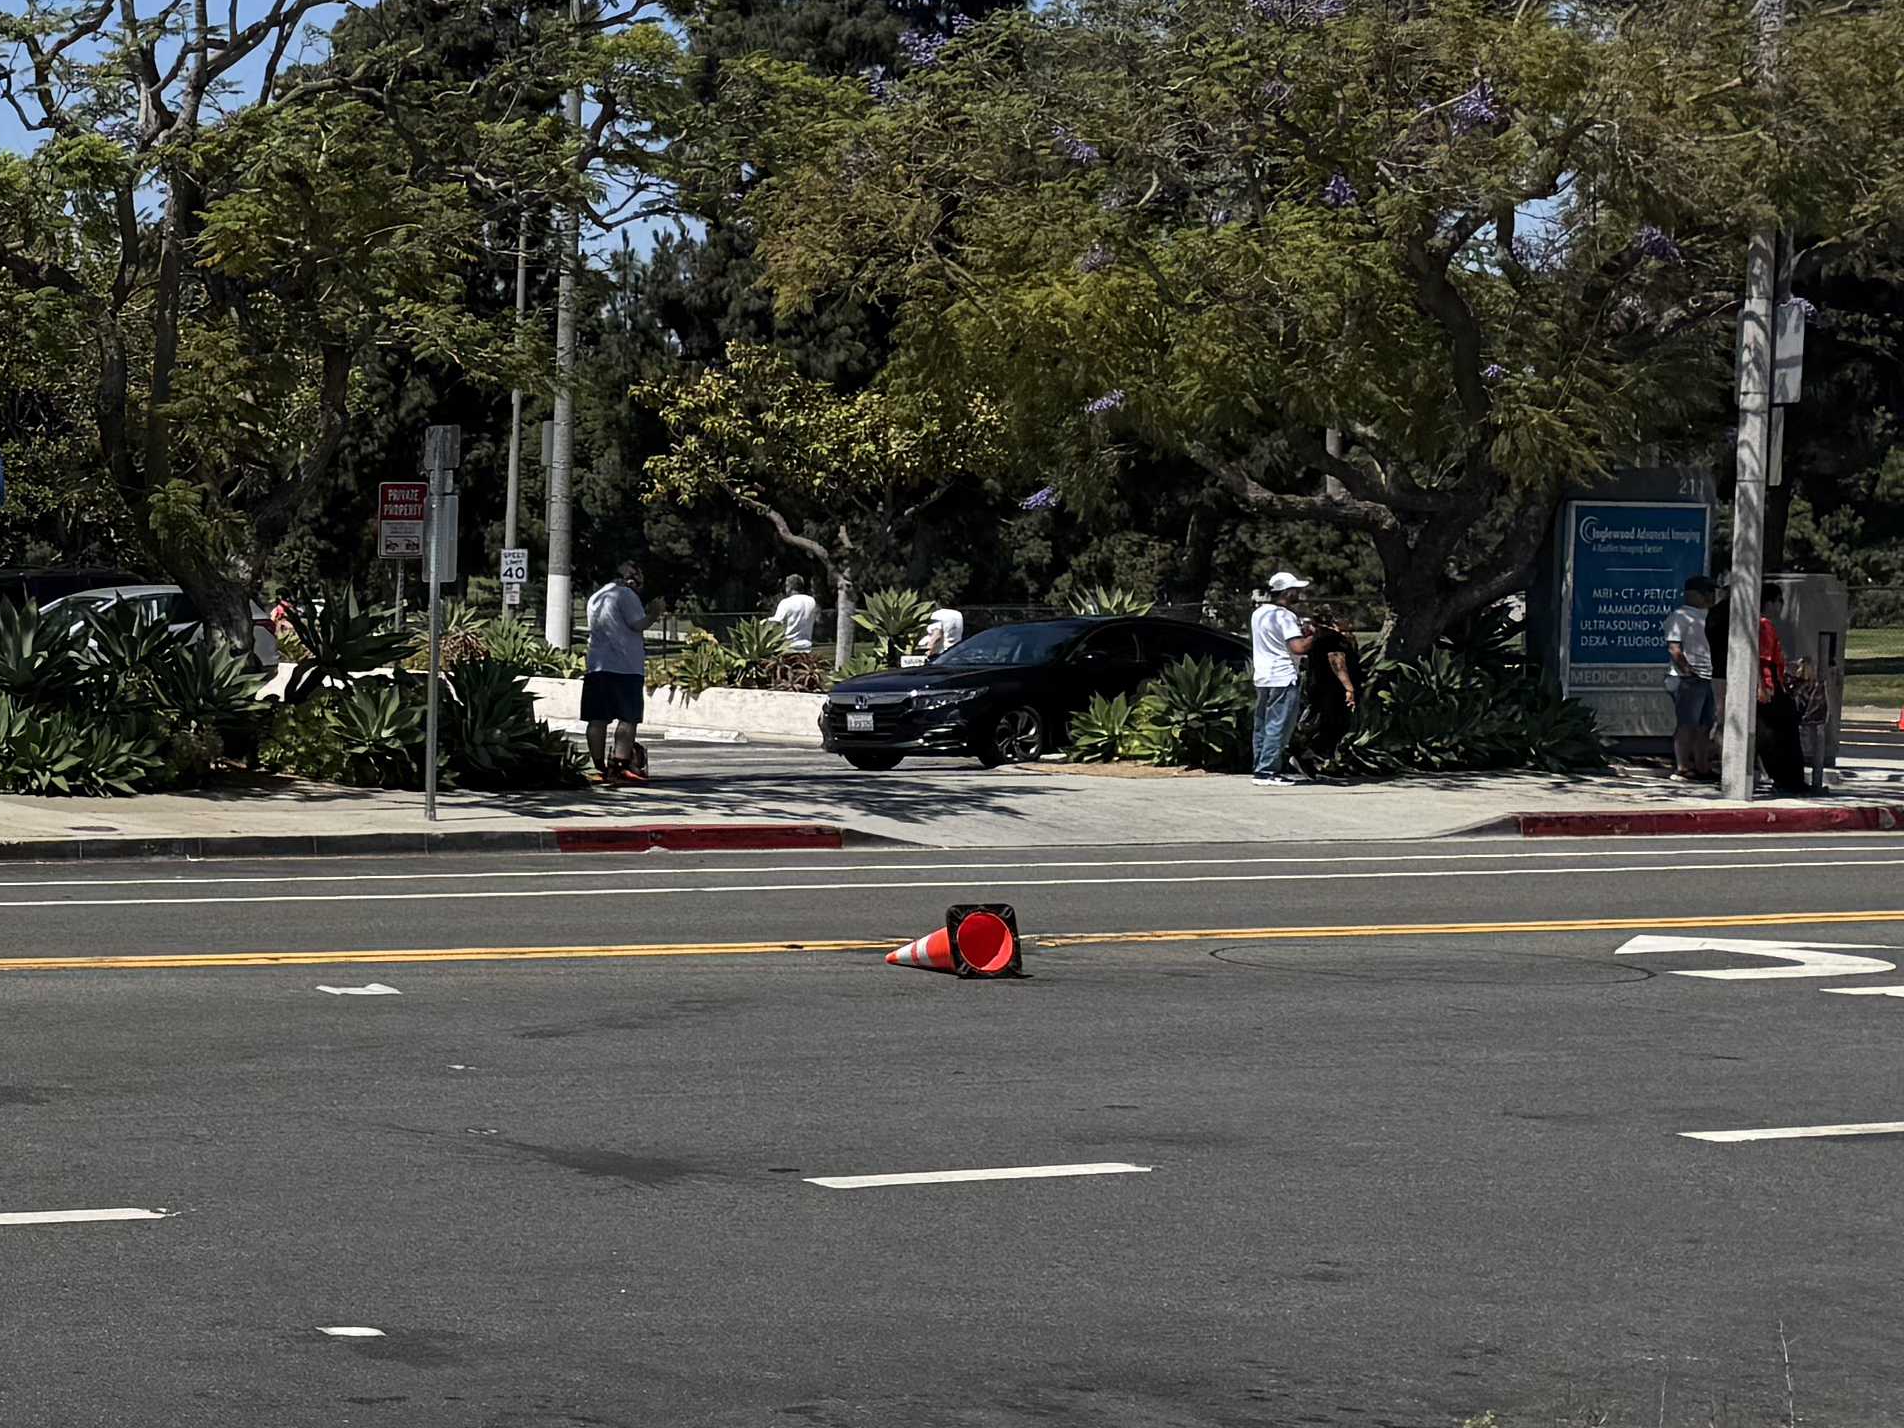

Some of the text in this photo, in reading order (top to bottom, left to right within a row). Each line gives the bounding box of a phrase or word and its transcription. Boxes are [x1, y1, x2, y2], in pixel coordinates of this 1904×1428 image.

[1679, 477, 1705, 495] 211
[503, 567, 525, 579] 40
[1592, 588, 1613, 599] MRI
[1621, 588, 1635, 599] CT
[1580, 620, 1650, 631] ULTRASOUND
[1580, 635, 1667, 647] DEXA FLUOROS
[1570, 669, 1632, 684] MEDICAL
